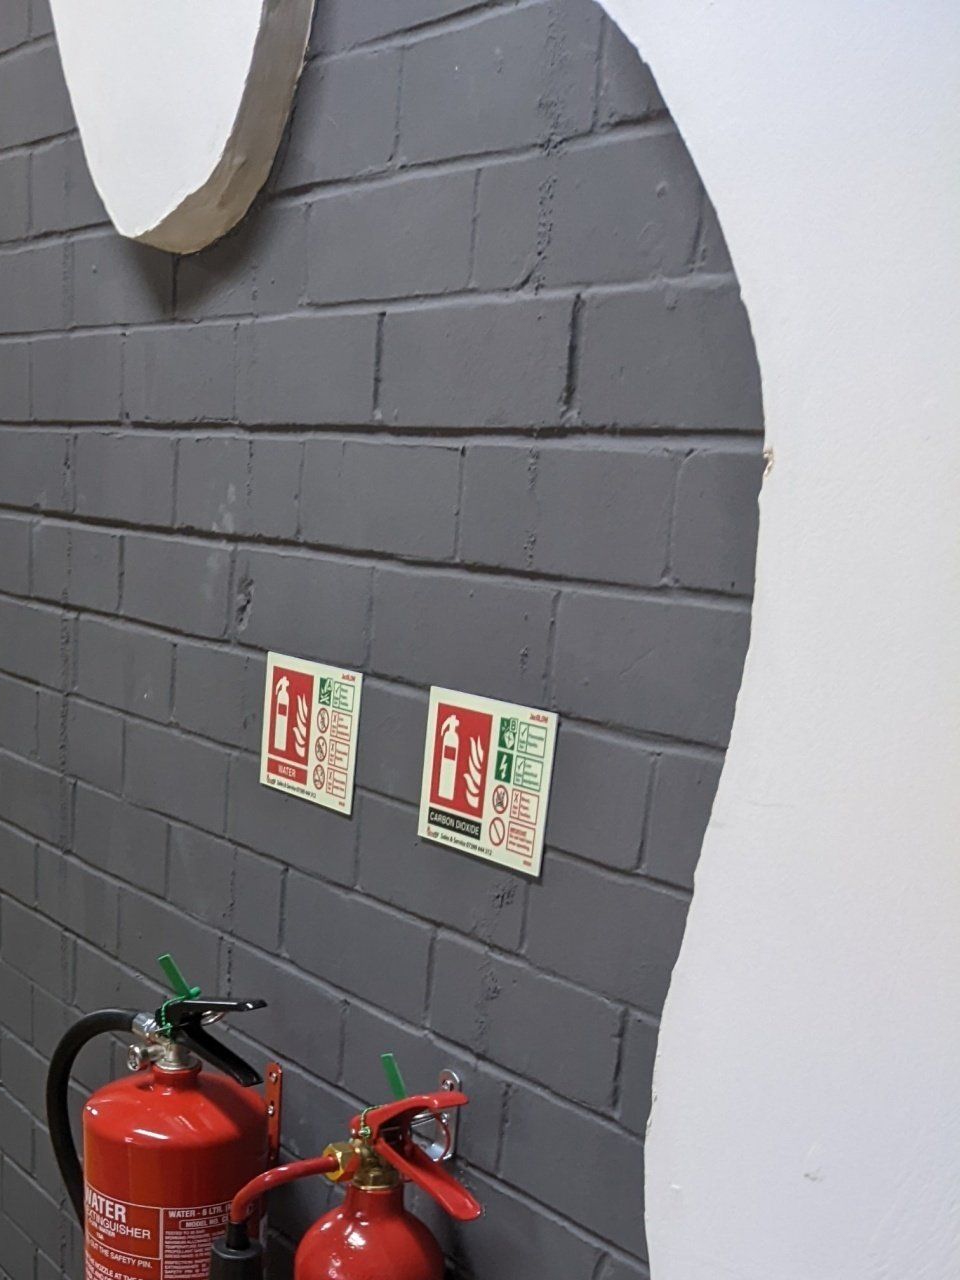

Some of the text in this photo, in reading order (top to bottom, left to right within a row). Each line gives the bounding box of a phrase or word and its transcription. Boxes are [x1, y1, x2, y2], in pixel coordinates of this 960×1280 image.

[278, 764, 296, 779] WATER
[429, 811, 455, 828] CARBON
[455, 820, 480, 835] DIOXIDE
[168, 1209, 196, 1218] WATER
[110, 1251, 137, 1266] SAFETY
[137, 1259, 153, 1269] PIN.
[114, 1271, 122, 1280] AT
